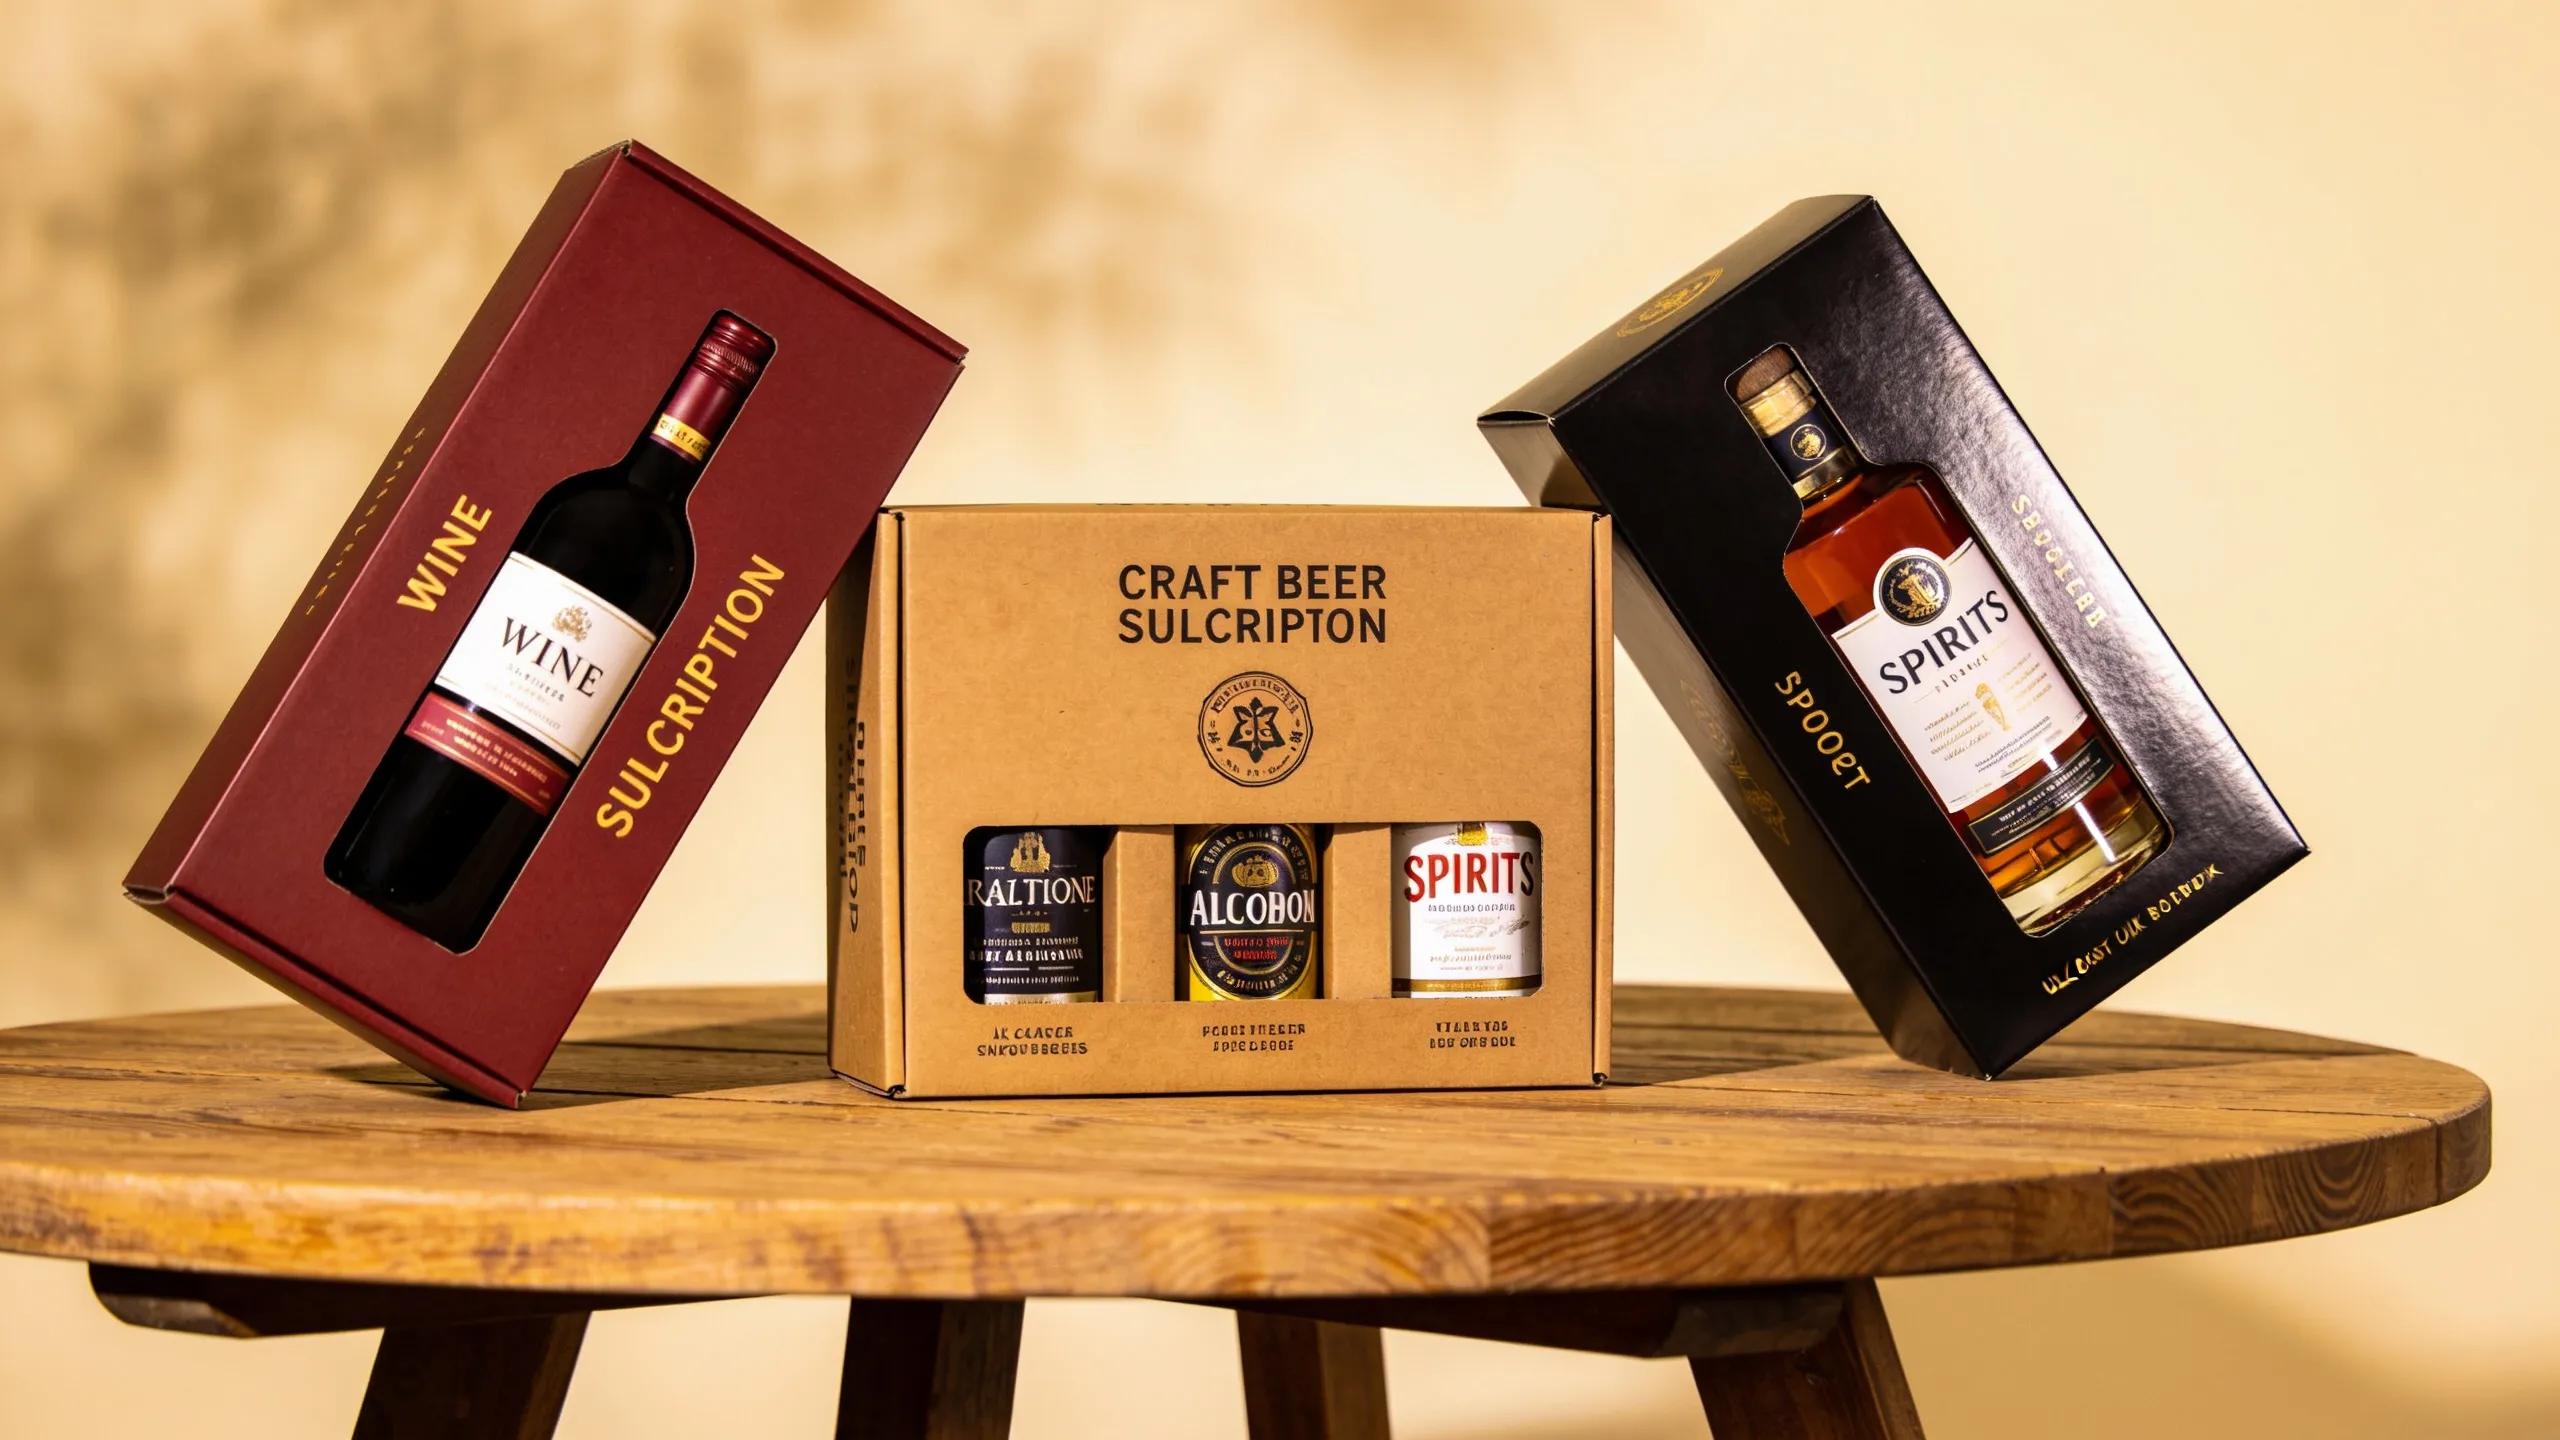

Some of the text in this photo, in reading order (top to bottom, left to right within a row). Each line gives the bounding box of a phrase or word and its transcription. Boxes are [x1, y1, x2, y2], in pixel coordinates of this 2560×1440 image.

[396, 495, 493, 612] WINE
[1118, 564, 1387, 600] CRAFT BEER
[501, 616, 604, 698] WINE
[1118, 607, 1387, 644] SULCRIPTON
[1879, 590, 2009, 694] SPIRITS
[596, 553, 785, 838] SULCRIPTION
[967, 876, 1096, 907] RALTIONE
[1403, 851, 1535, 903] SPIRITS
